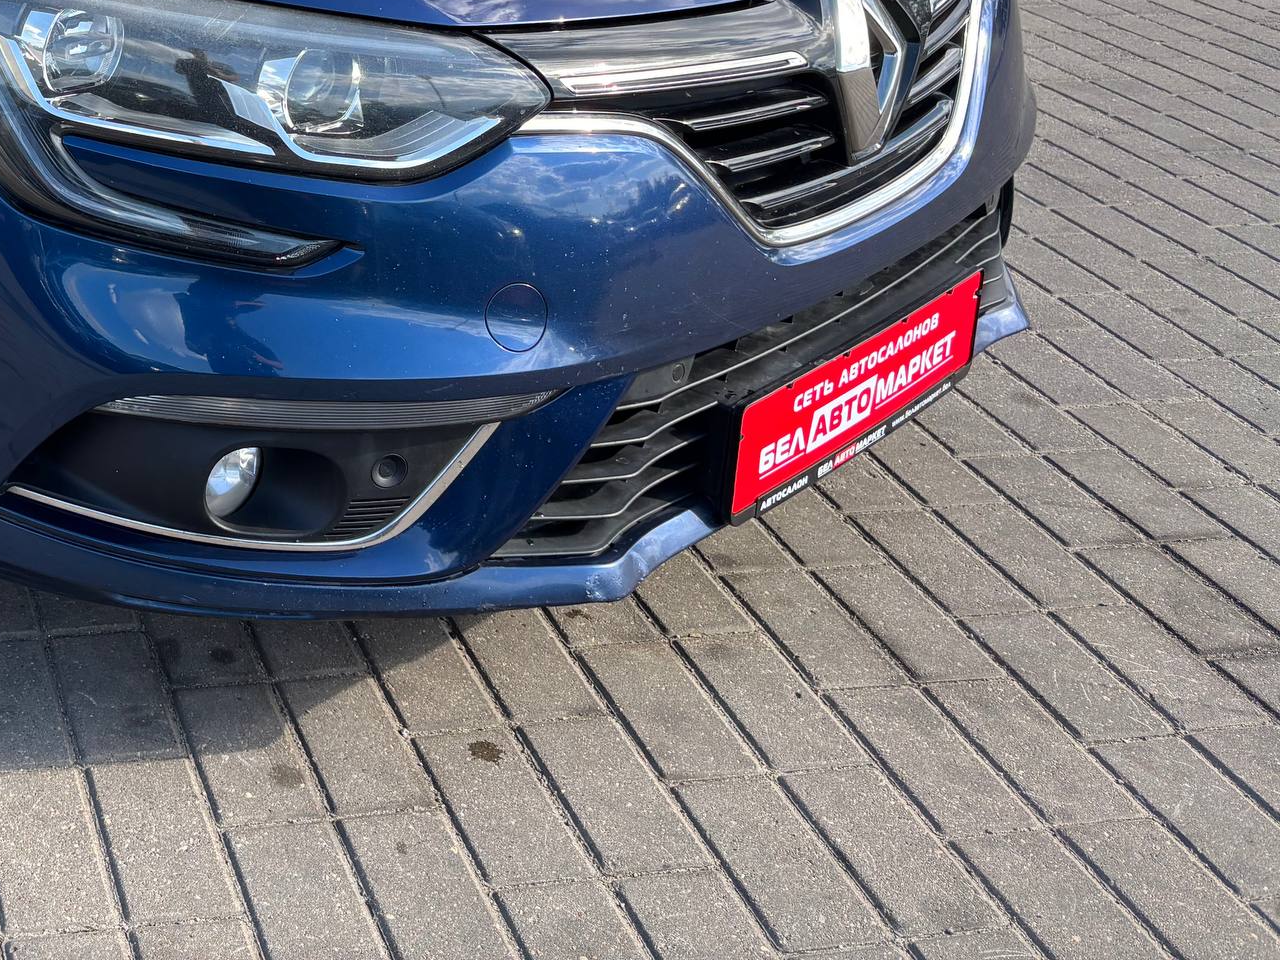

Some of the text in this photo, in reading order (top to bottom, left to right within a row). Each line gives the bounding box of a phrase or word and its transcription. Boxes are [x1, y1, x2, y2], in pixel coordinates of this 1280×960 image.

[793, 379, 834, 413] СЕТЬ
[838, 312, 939, 388] АВТОСАЛОНОВ
[760, 475, 809, 511] АВТОСАЛОН
